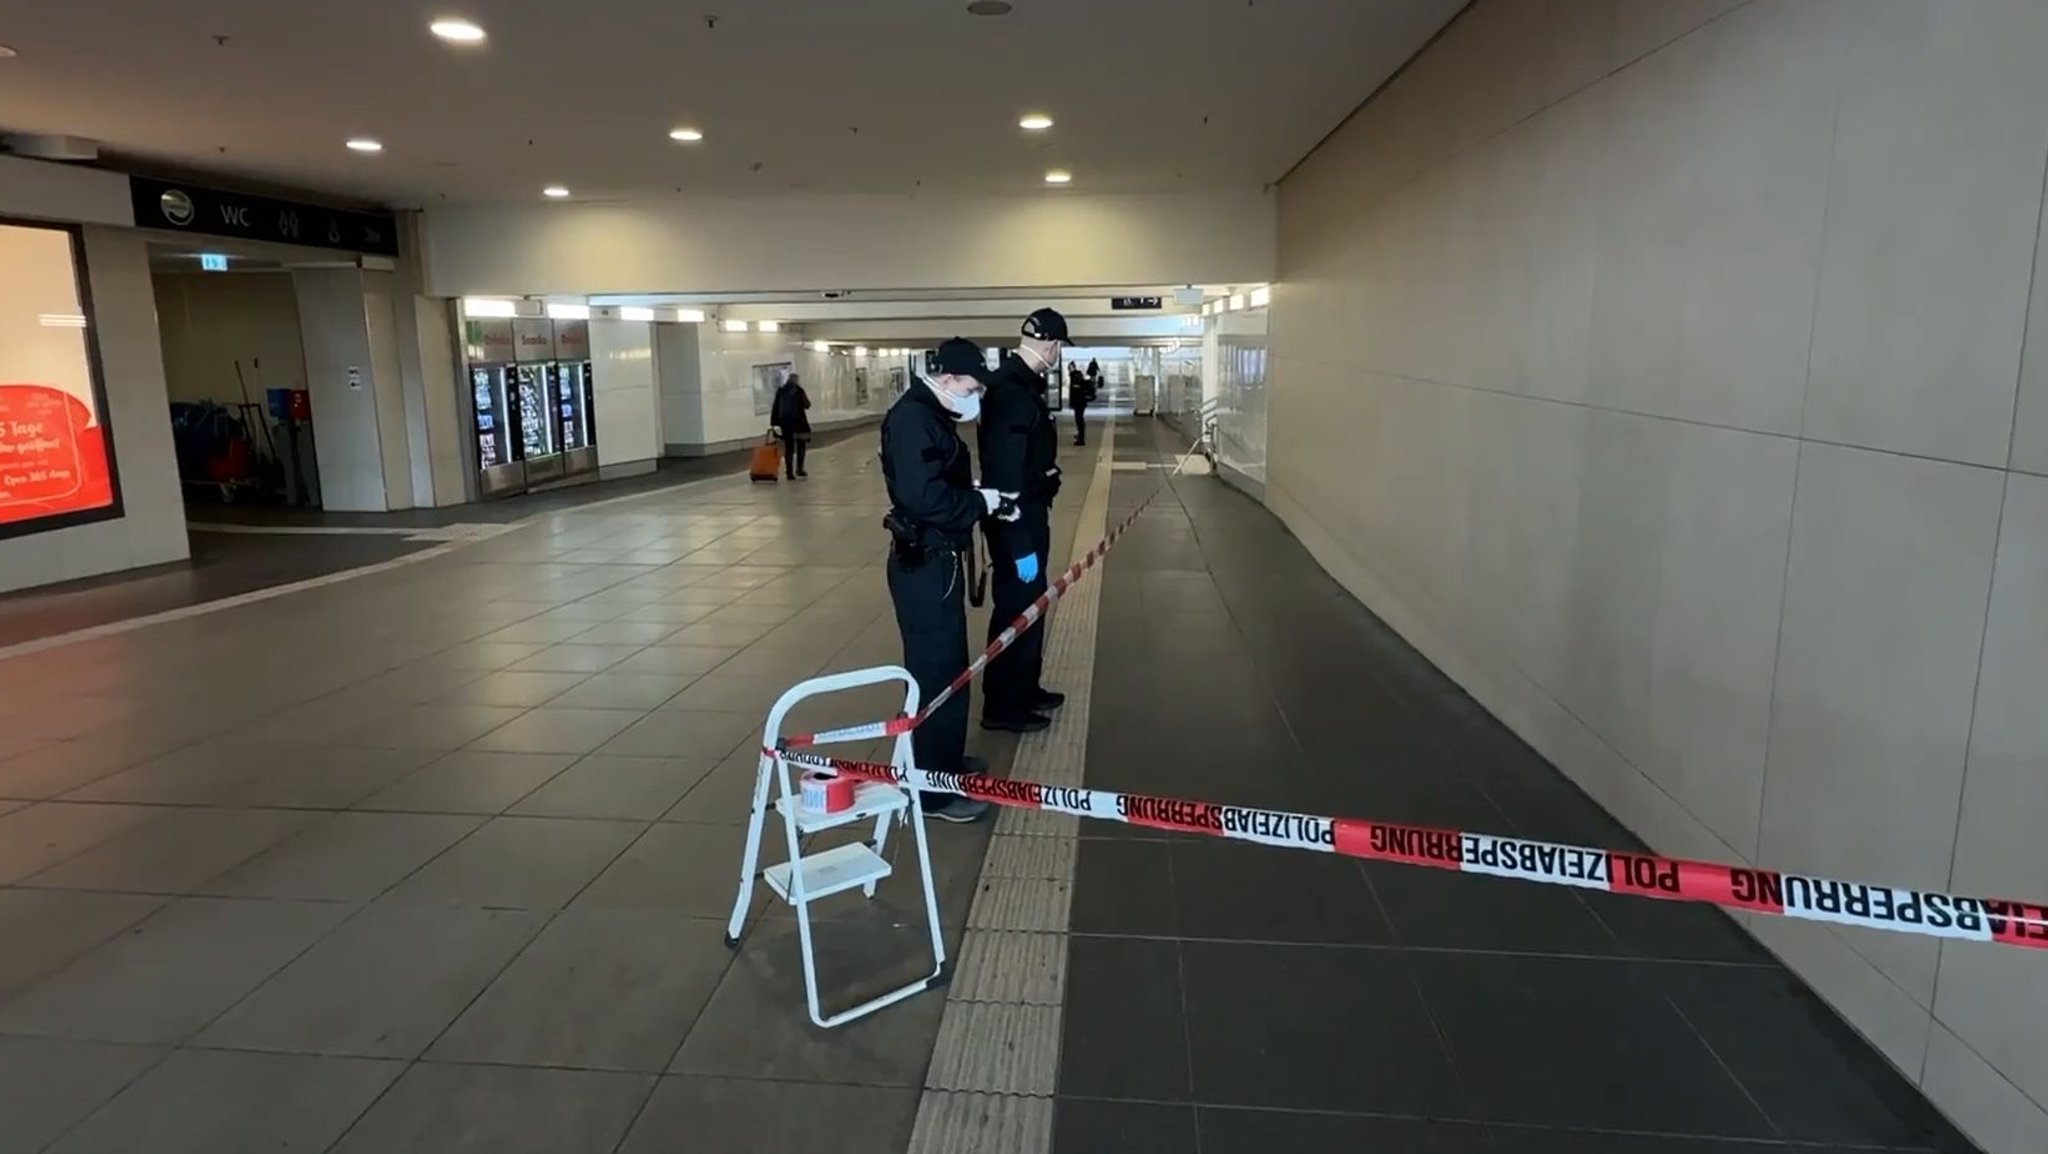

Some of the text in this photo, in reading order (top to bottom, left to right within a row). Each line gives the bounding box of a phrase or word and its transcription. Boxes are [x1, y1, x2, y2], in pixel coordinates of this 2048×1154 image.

[219, 204, 251, 228] WC
[7, 420, 44, 438] Tage
[926, 770, 1093, 812] POLIZEIABSPERRUNG
[1116, 795, 1336, 845] POLIZEIABSPERRUNG
[1370, 825, 1681, 893] POLIZEIABSPERRUNG
